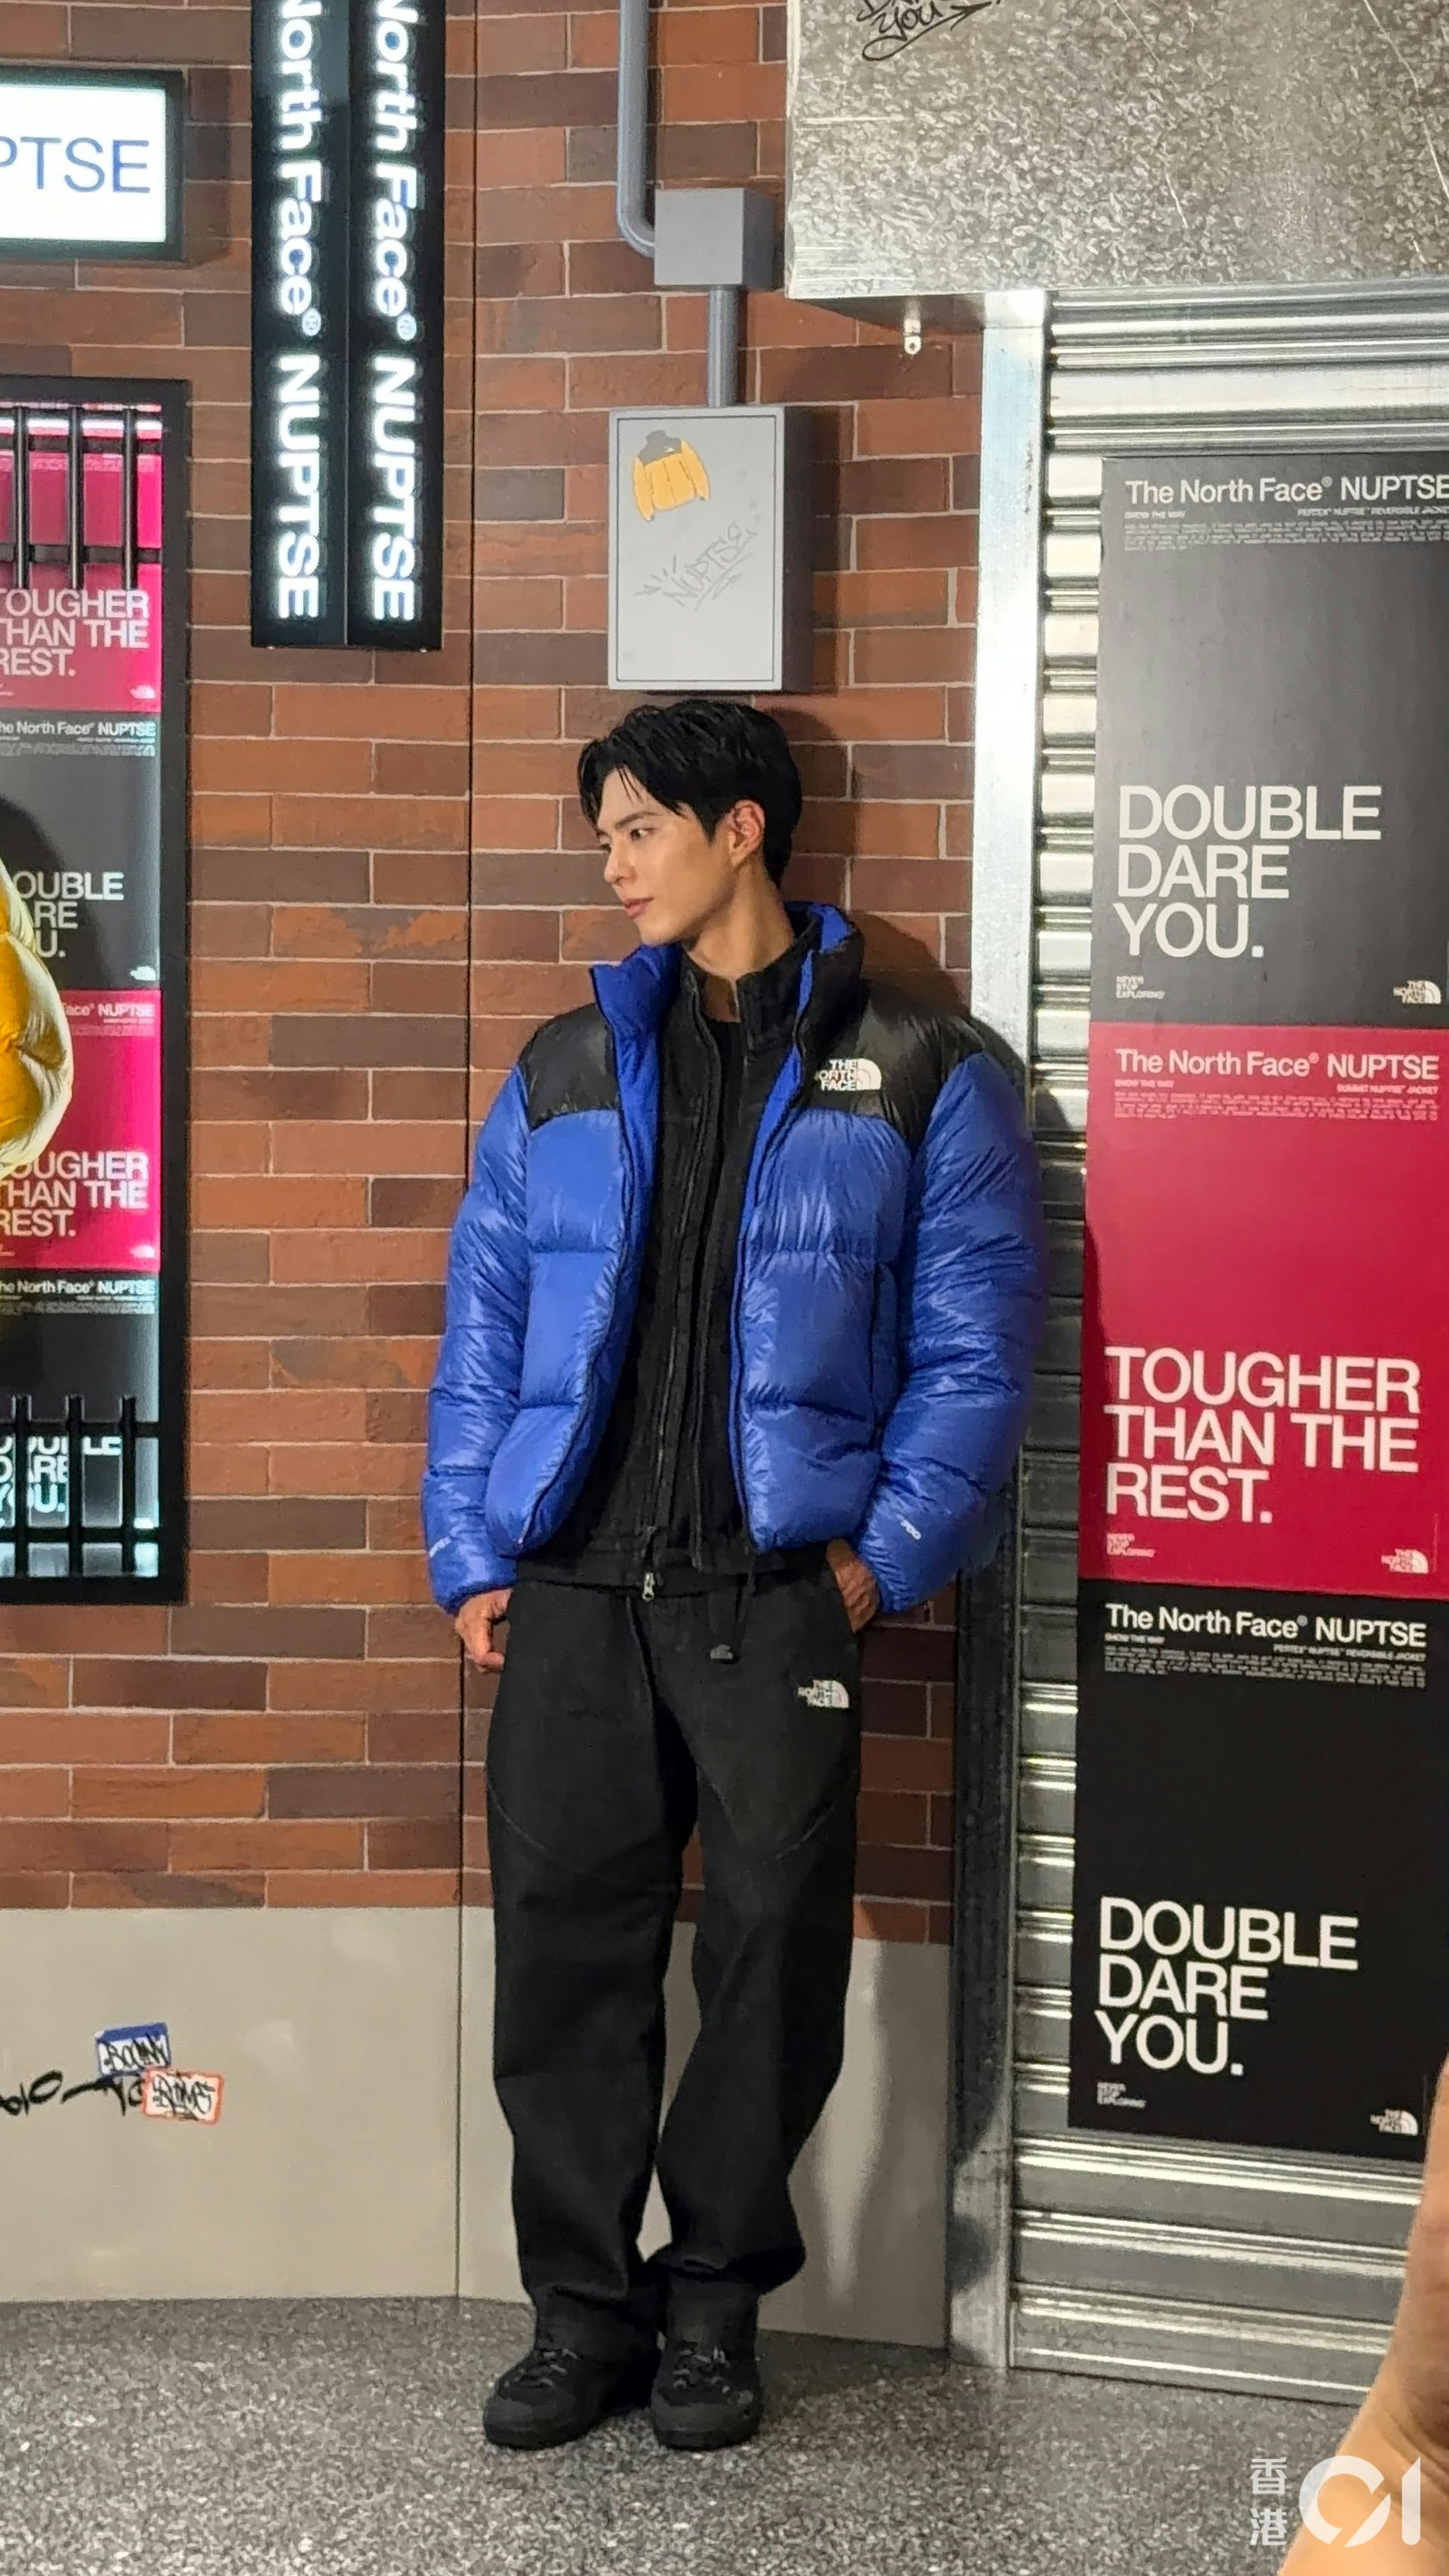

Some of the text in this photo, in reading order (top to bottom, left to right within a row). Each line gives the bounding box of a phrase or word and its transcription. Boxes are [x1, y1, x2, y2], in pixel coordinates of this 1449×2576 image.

[278, 354, 320, 619] NUPTSE
[374, 356, 415, 621] NUPTSE
[1124, 479, 1174, 504] The
[1180, 478, 1254, 503] North
[1340, 473, 1449, 500] NUPTSE
[0, 588, 150, 619] OUGHER
[82, 619, 150, 649] THE
[17, 721, 55, 734] North
[97, 722, 155, 737] NUPTSE
[1118, 784, 1382, 841] DOUBLE
[13, 871, 125, 900] OUBLE
[1117, 845, 1290, 899] DARE
[34, 900, 78, 929] RE
[1112, 901, 1264, 959] YOU.
[97, 1003, 155, 1017] NUPTSE
[829, 1059, 857, 1069] THE
[1115, 1048, 1164, 1073] The
[1169, 1049, 1241, 1076] North
[1327, 1053, 1441, 1080] NUPTSE
[821, 1079, 857, 1091] FACE
[11, 1150, 149, 1180] UGHER
[83, 1179, 149, 1208] THE
[17, 1279, 56, 1294] North
[97, 1279, 156, 1296] NUPTSE
[1104, 1346, 1421, 1414] TOUGHER
[1104, 1405, 1419, 1473] THAN THE
[1106, 1463, 1273, 1525] REST.
[1105, 1602, 1154, 1630] The
[1158, 1606, 1232, 1636] North
[1315, 1616, 1427, 1647] NUPTSE
[1100, 1895, 1358, 1971] DOUBLE
[1098, 1953, 1269, 2020] DARE
[1094, 2010, 1244, 2076] YOU.
